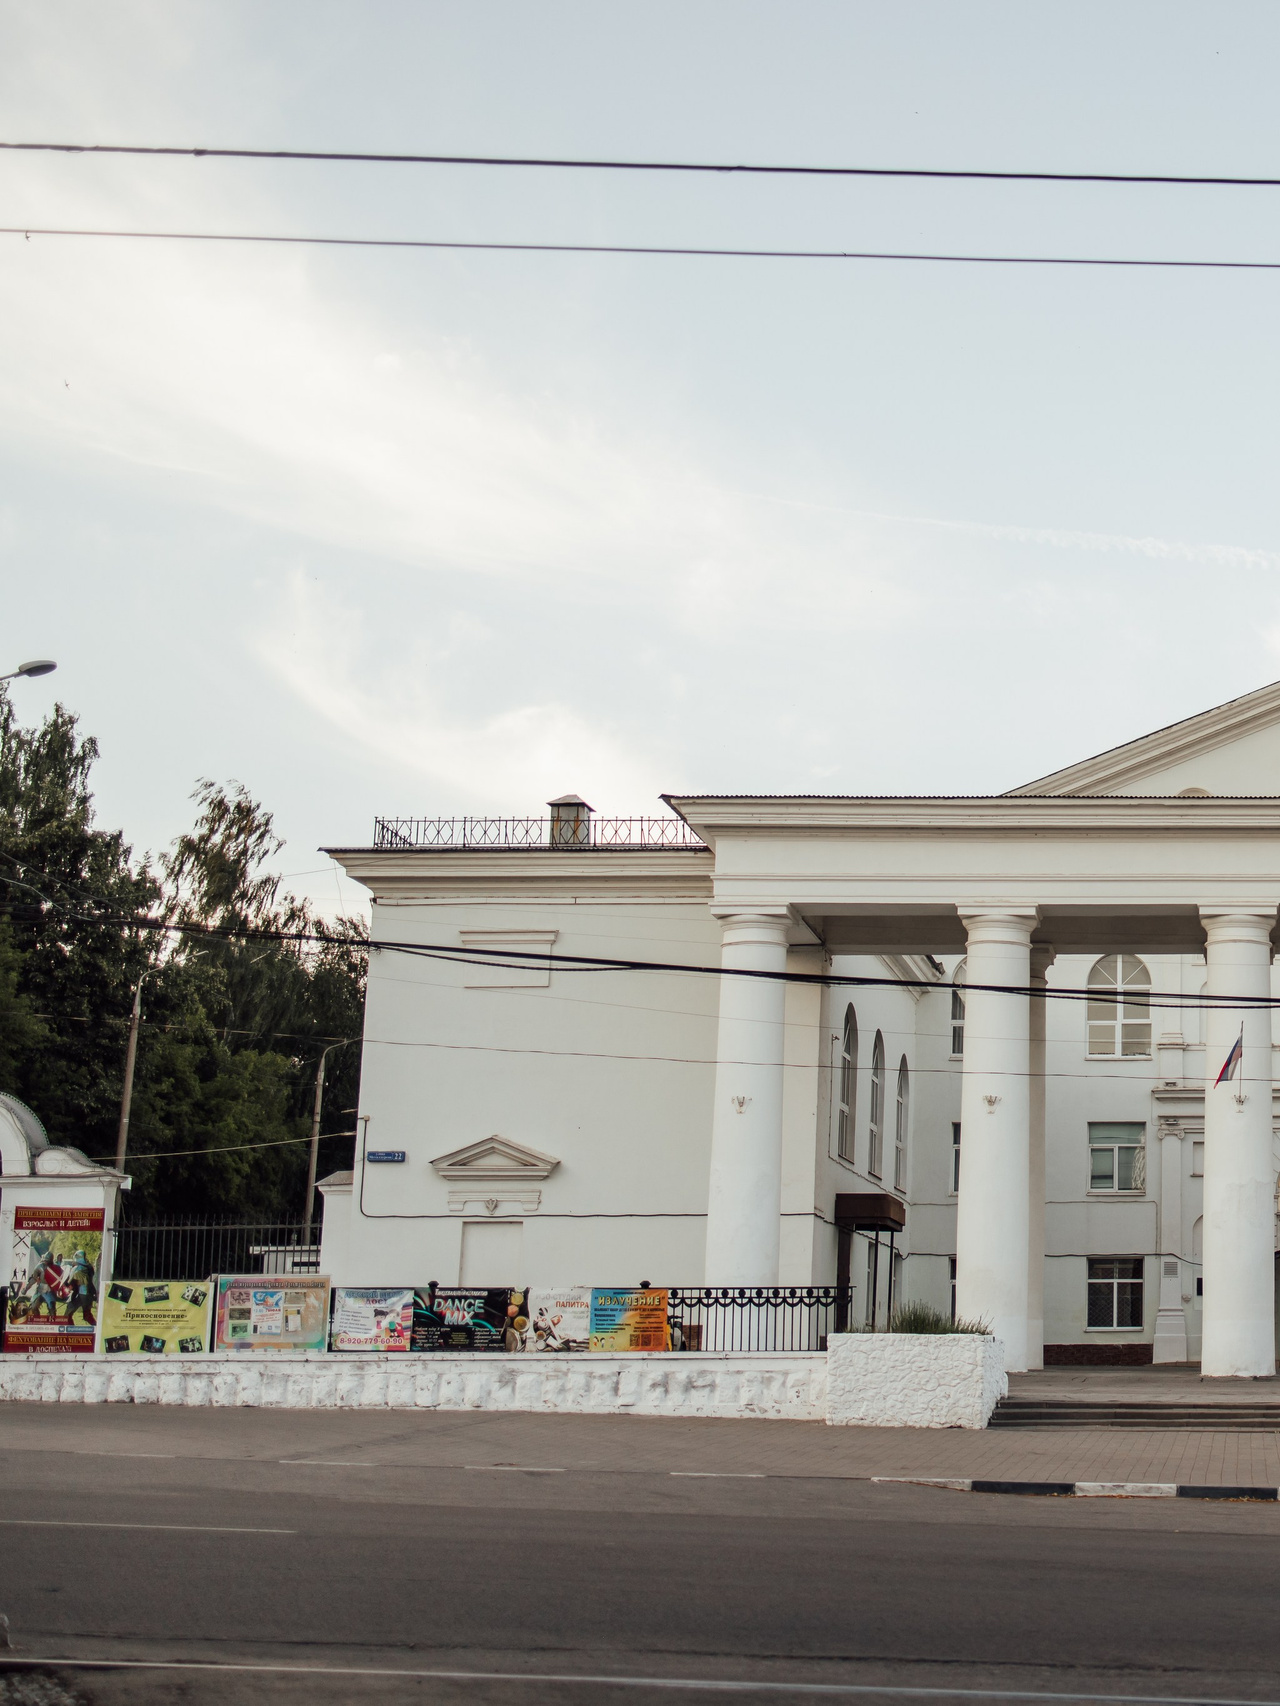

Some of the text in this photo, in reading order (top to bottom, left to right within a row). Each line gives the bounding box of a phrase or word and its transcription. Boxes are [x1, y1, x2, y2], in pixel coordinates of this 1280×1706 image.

[433, 1298, 485, 1312] DANCE
[444, 1311, 475, 1325] MIX
[340, 1337, 403, 1345] 8-920-779-60-90
